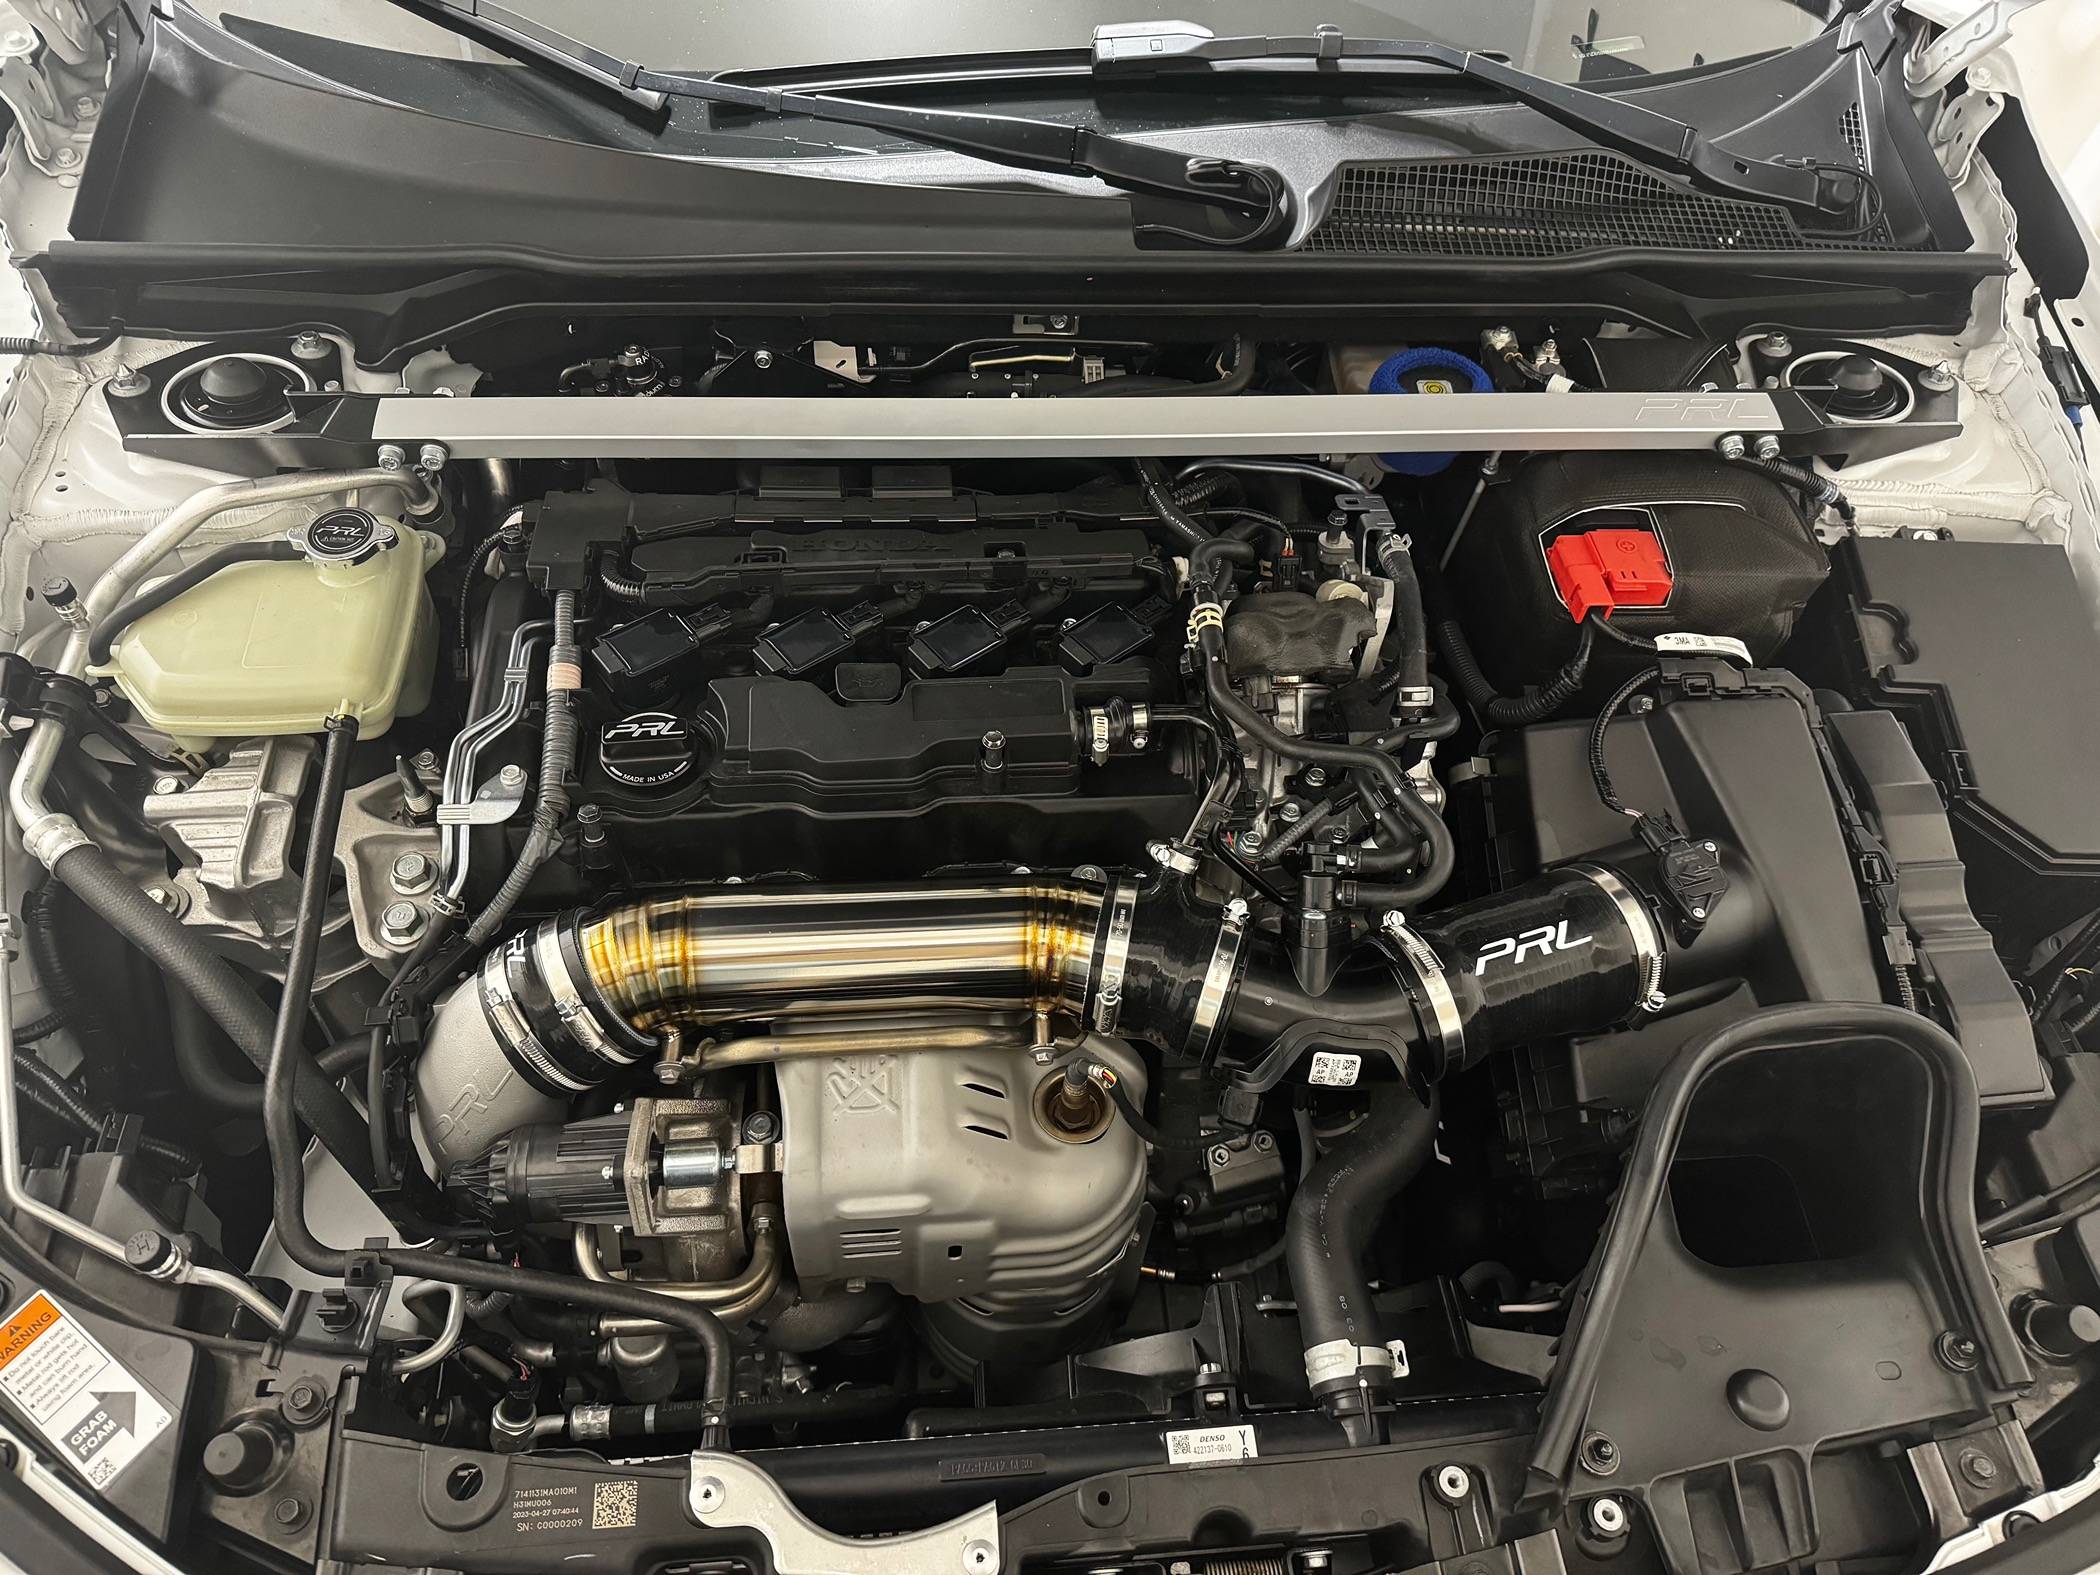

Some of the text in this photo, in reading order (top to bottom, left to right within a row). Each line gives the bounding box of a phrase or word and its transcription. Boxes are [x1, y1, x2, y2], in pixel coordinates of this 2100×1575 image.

[1634, 398, 1769, 422] PRL
[316, 525, 365, 537] PRL
[604, 721, 685, 739] PRL
[622, 773, 645, 783] MADE
[658, 771, 675, 781] USA
[1475, 919, 1593, 977] PRL
[430, 1068, 514, 1155] PRL
[70, 1410, 108, 1446] GRAB
[78, 1419, 117, 1456] FOAM
[1199, 1434, 1226, 1443] DENSO
[1238, 1429, 1246, 1446] Y
[1242, 1446, 1250, 1459] 6
[512, 1509, 551, 1519] 2023-04-27
[516, 1522, 534, 1532] SN:
